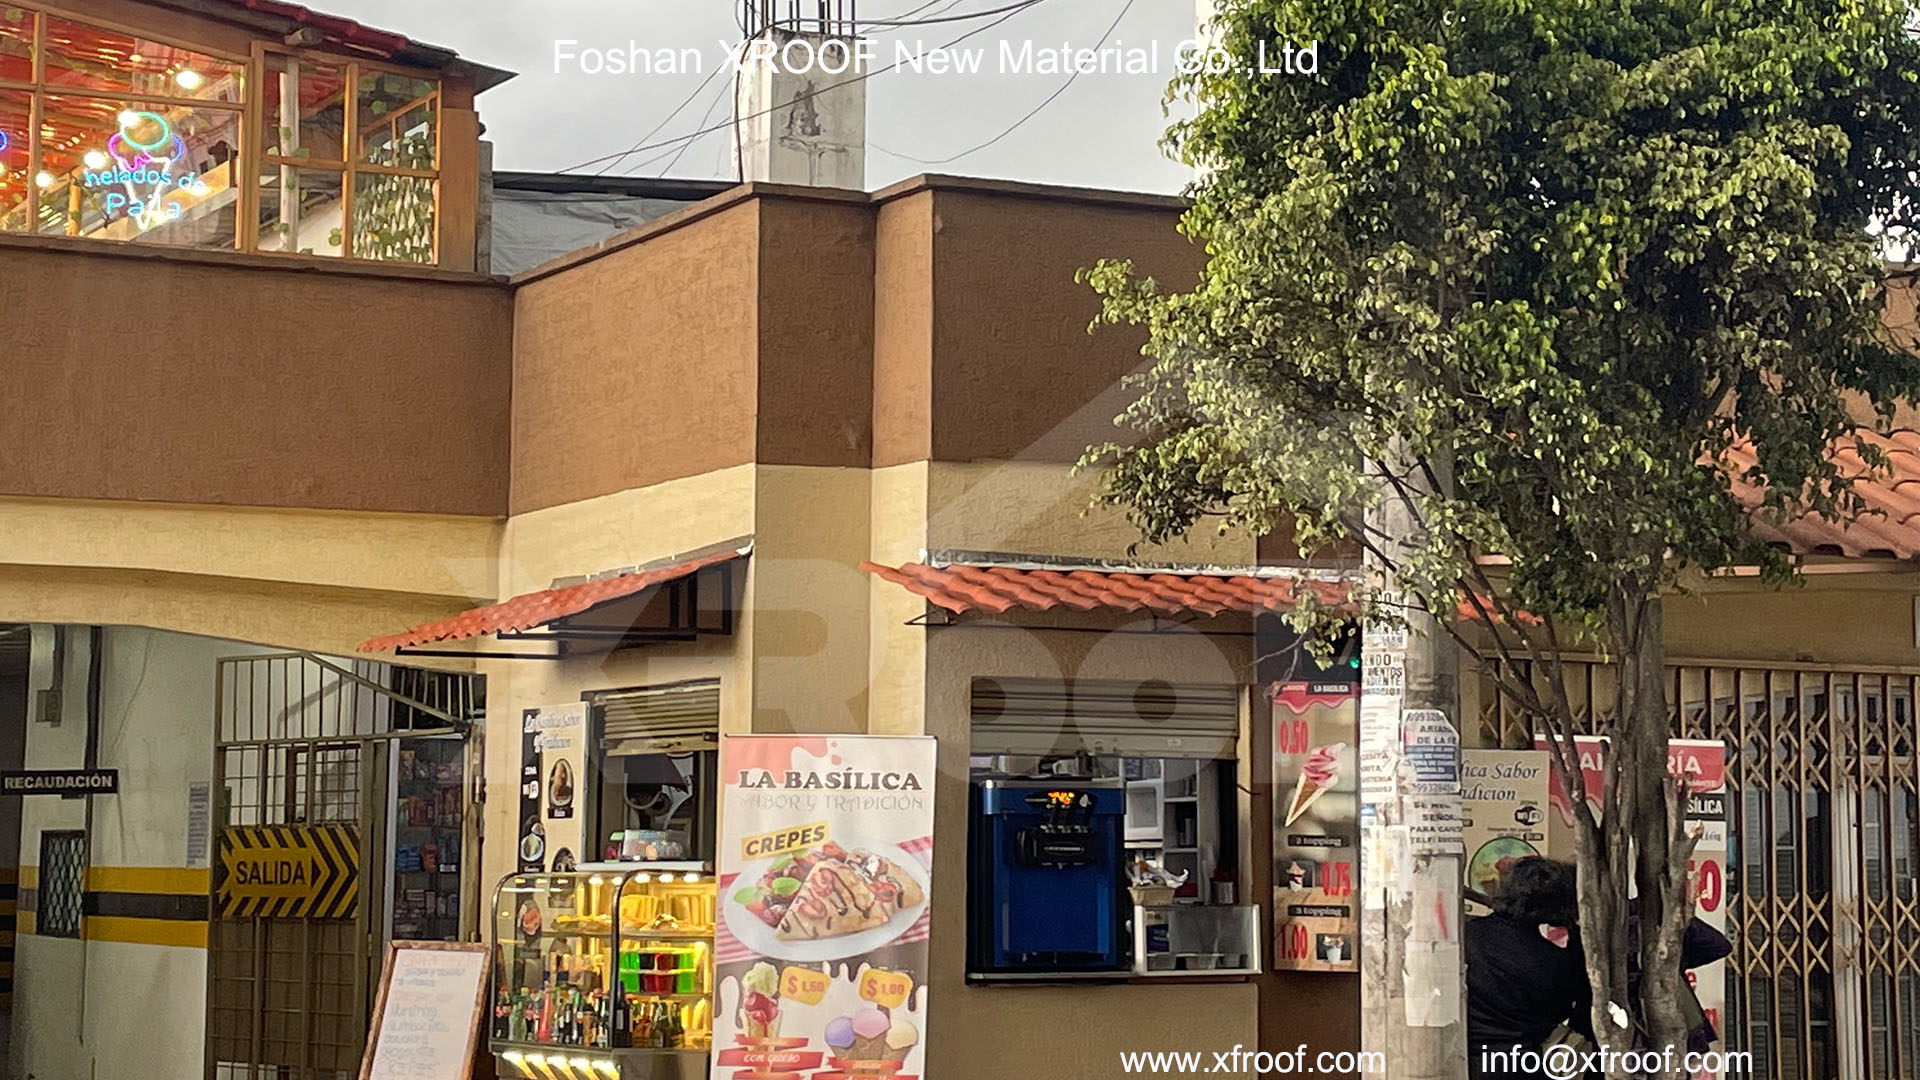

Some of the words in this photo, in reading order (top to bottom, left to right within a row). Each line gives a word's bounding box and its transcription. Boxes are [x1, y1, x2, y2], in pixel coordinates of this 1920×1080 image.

[83, 165, 172, 187] helados
[1417, 736, 1431, 744] DE
[1434, 736, 1445, 744] LA
[4, 772, 113, 789] RECAUDACIÓN
[739, 770, 776, 788] LA
[784, 767, 922, 790] BASÍLICA
[1491, 761, 1540, 779] Sabor
[824, 793, 923, 811] TRADICIÓN
[745, 825, 826, 857] CREPES
[235, 861, 305, 885] SALIDA
[1281, 924, 1308, 959] 1.00
